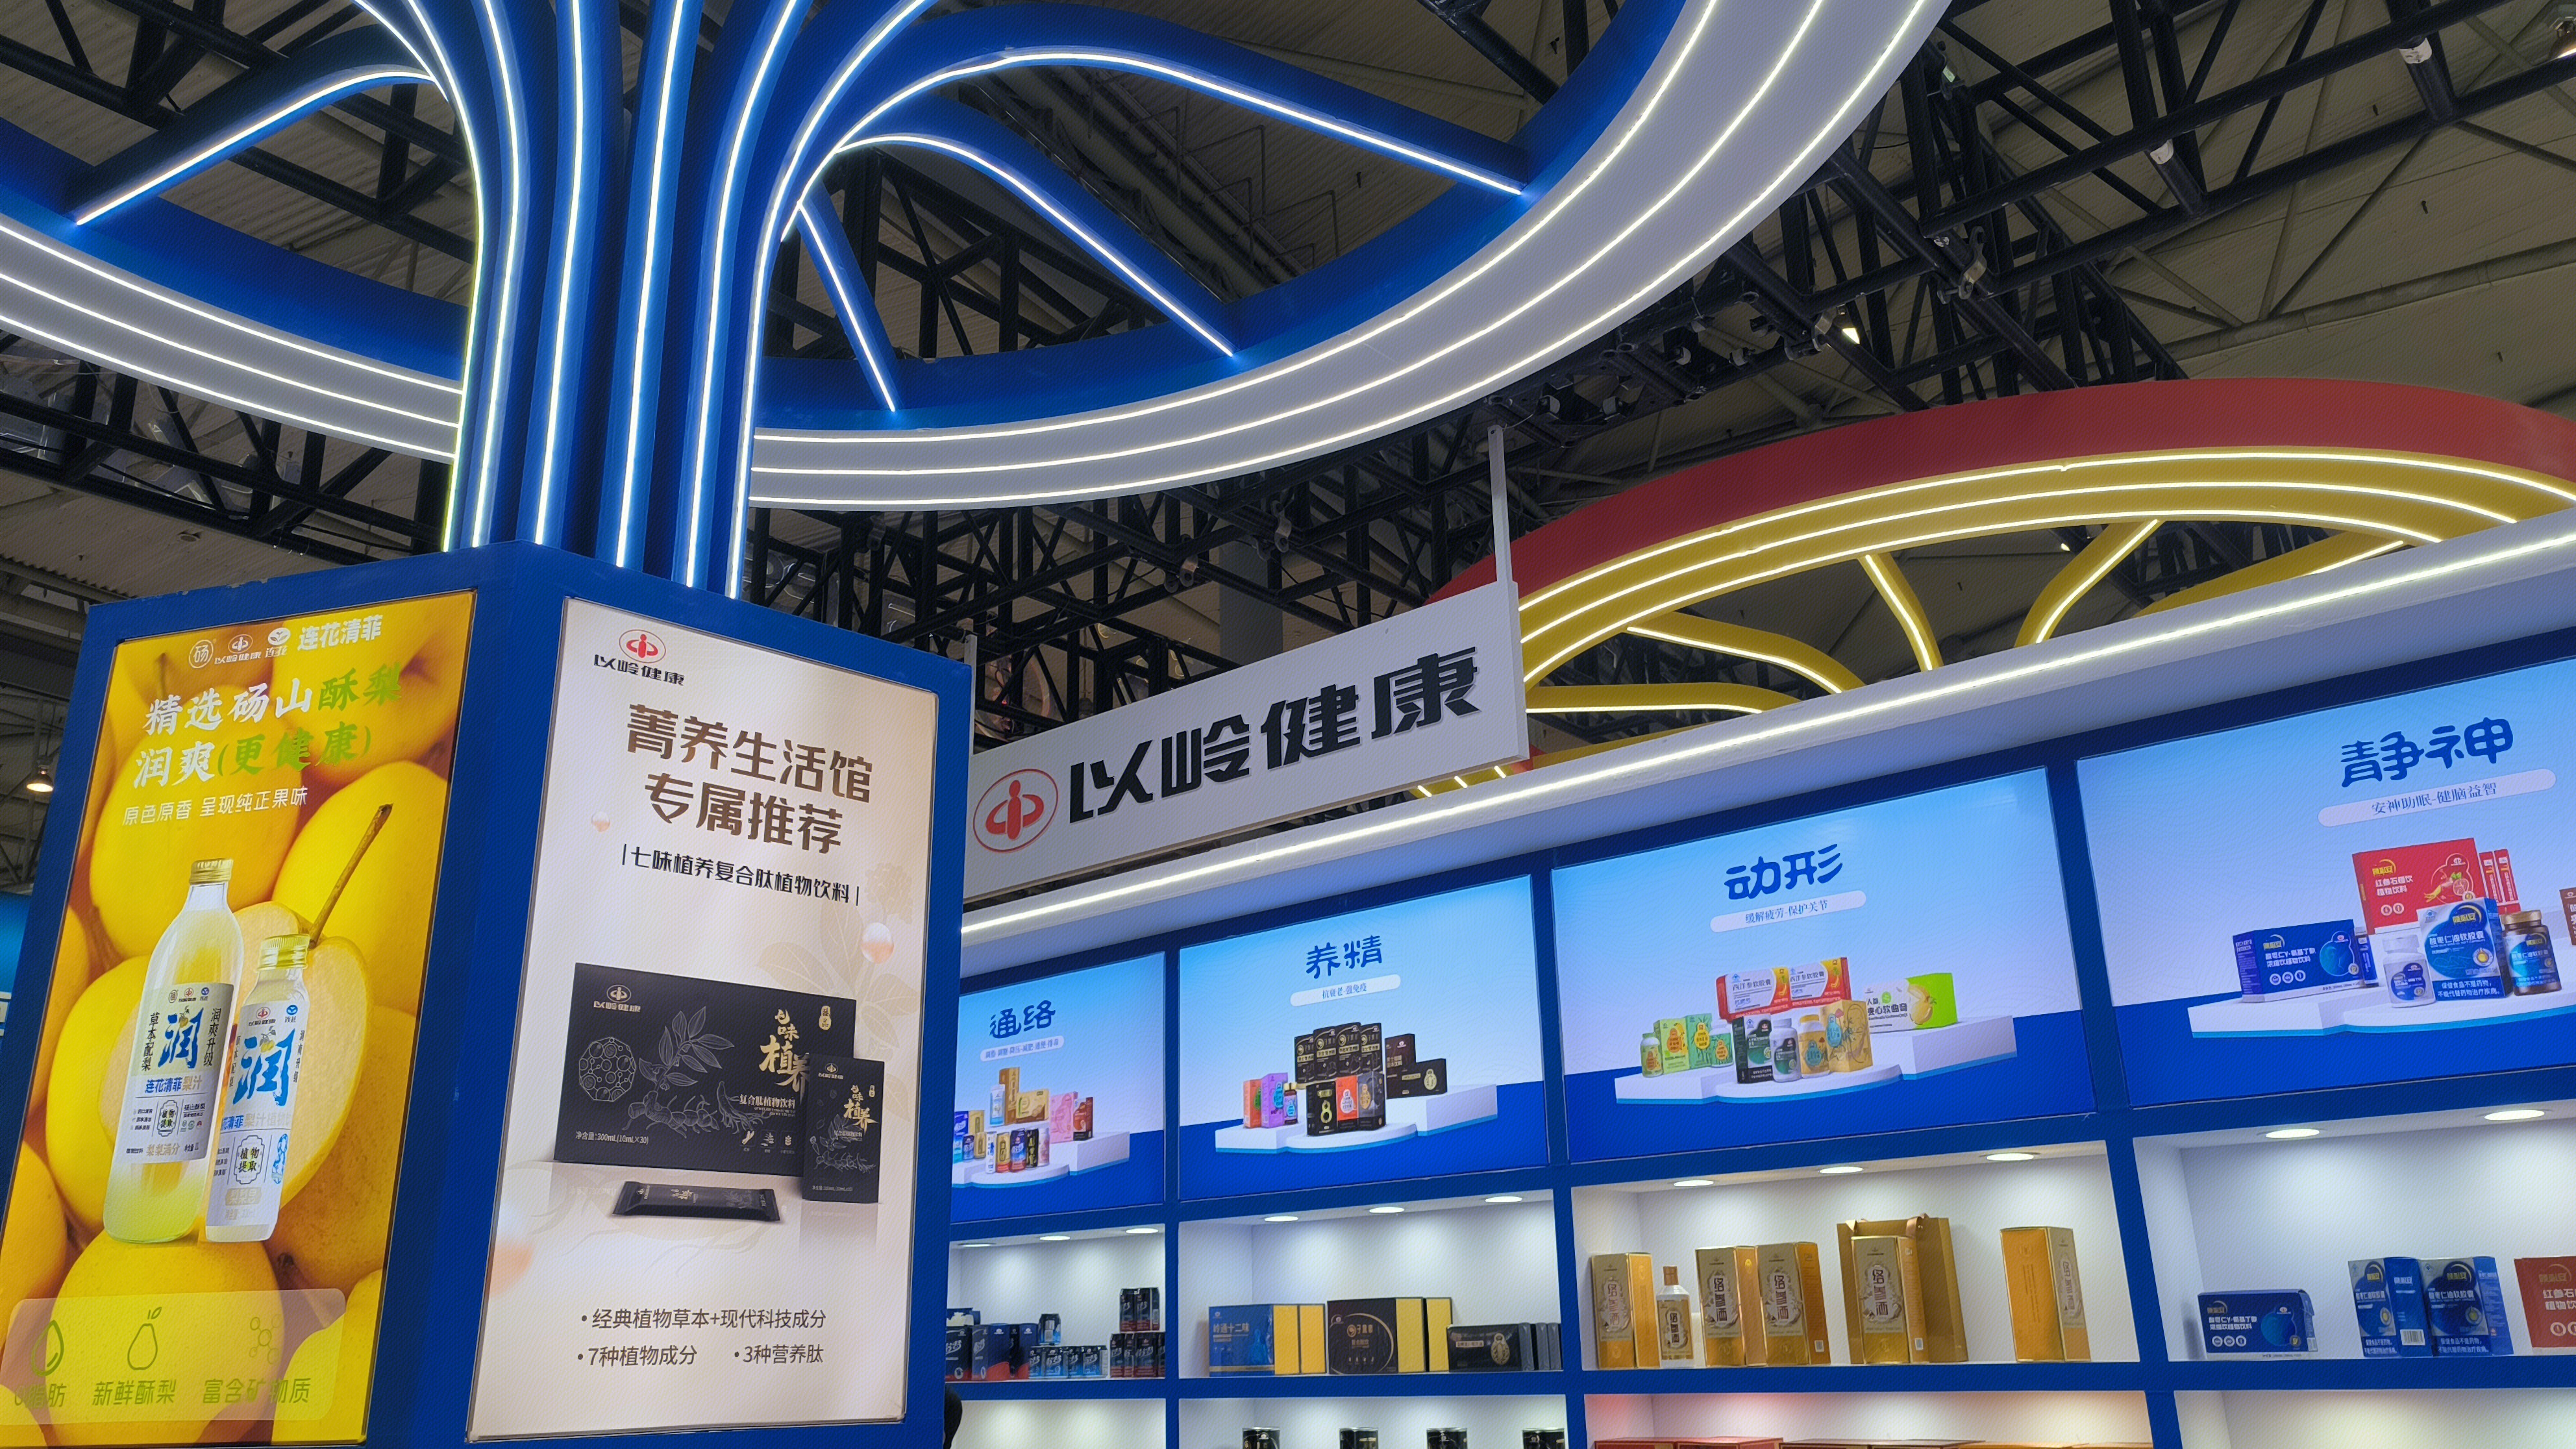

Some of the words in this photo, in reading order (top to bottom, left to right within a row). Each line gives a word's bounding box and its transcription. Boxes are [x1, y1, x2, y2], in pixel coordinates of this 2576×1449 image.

[297, 614, 383, 651] 连花清菲
[593, 654, 685, 687] 以岭健康
[142, 661, 402, 736] 精选砀山酥梨
[626, 704, 873, 804] 菁养生活馆
[1069, 645, 1481, 824] 以岭健康
[121, 799, 193, 827] 原色原香
[199, 786, 308, 816] 呈现纯正果味
[644, 773, 843, 854] 专属推荐
[630, 847, 850, 903] 七味植养复合肽植物饮料
[1724, 843, 1843, 900] 动形
[1306, 935, 1383, 979] 养精
[989, 1000, 1056, 1039] 通络
[2543, 1289, 2576, 1299] 红参石
[592, 1307, 826, 1330] 经典植物草本+现代科技成分
[588, 1344, 697, 1367] 7种植物成分
[743, 1343, 824, 1364] 3种营养肽
[92, 1379, 177, 1406] 新鲜酥梨
[203, 1378, 312, 1404] 富含矿物质
